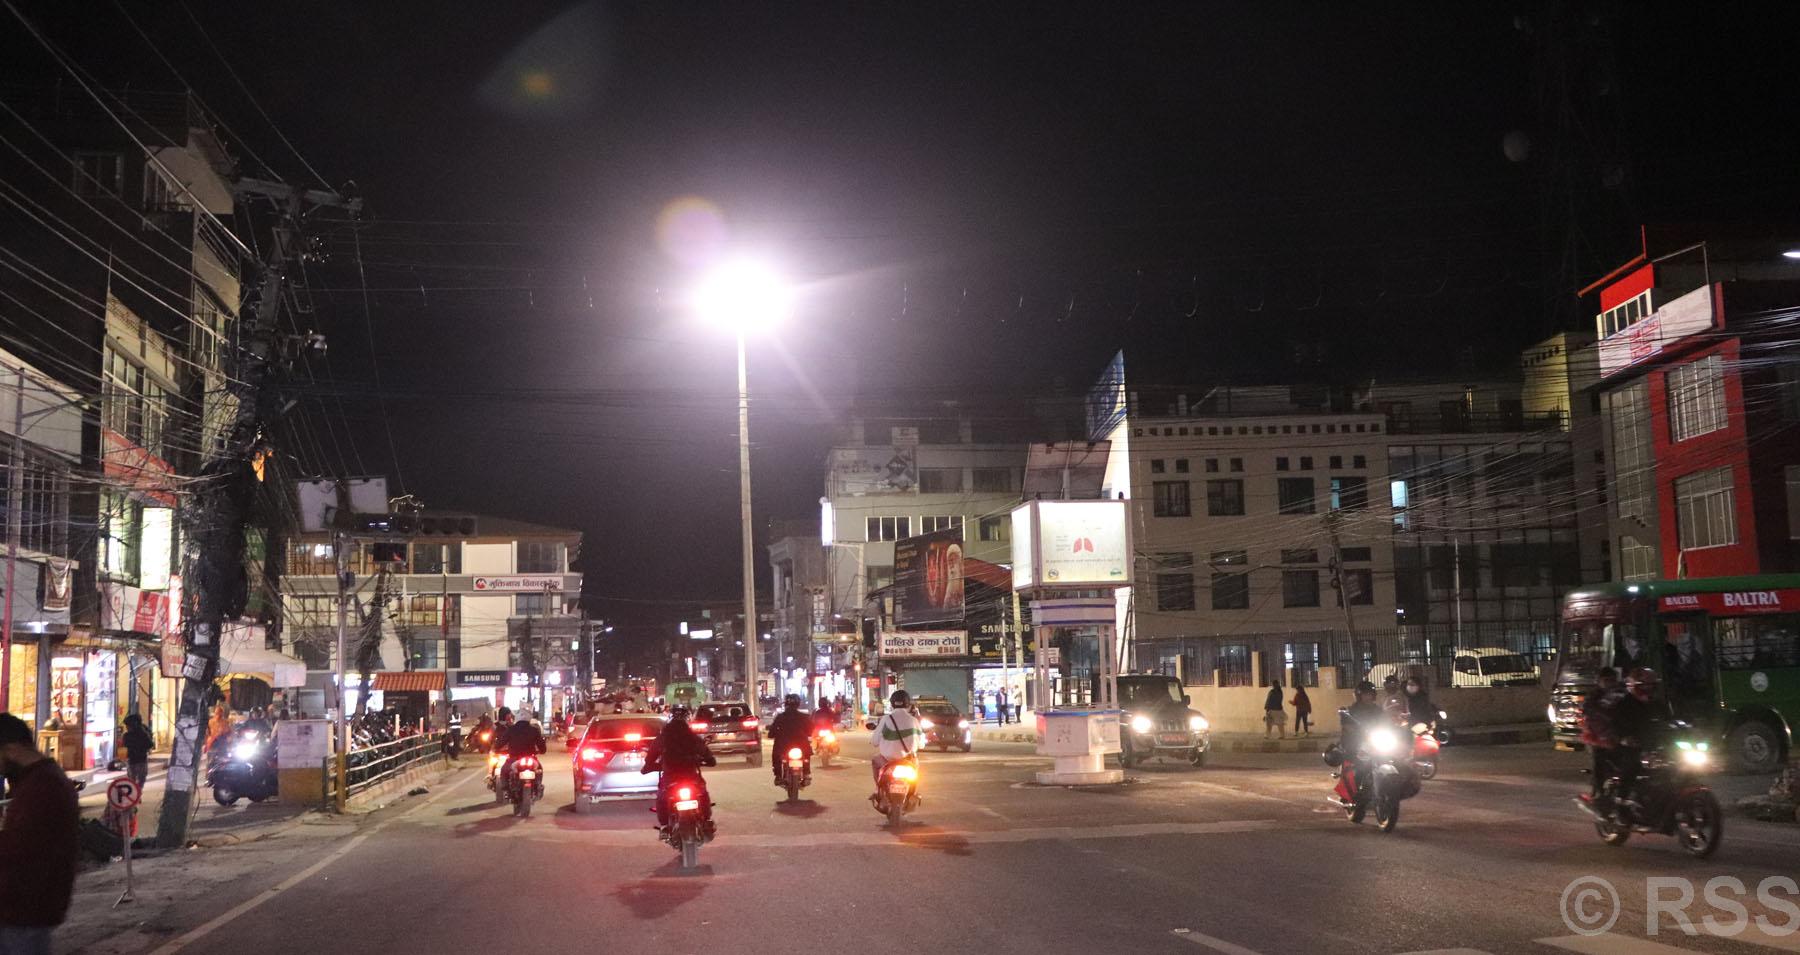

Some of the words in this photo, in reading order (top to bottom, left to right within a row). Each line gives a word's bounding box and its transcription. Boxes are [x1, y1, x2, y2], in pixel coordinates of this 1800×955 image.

[1665, 595, 1699, 606] BALTRA
[1723, 591, 1780, 607] BALTRA
[464, 674, 501, 683] SAMSUNG
